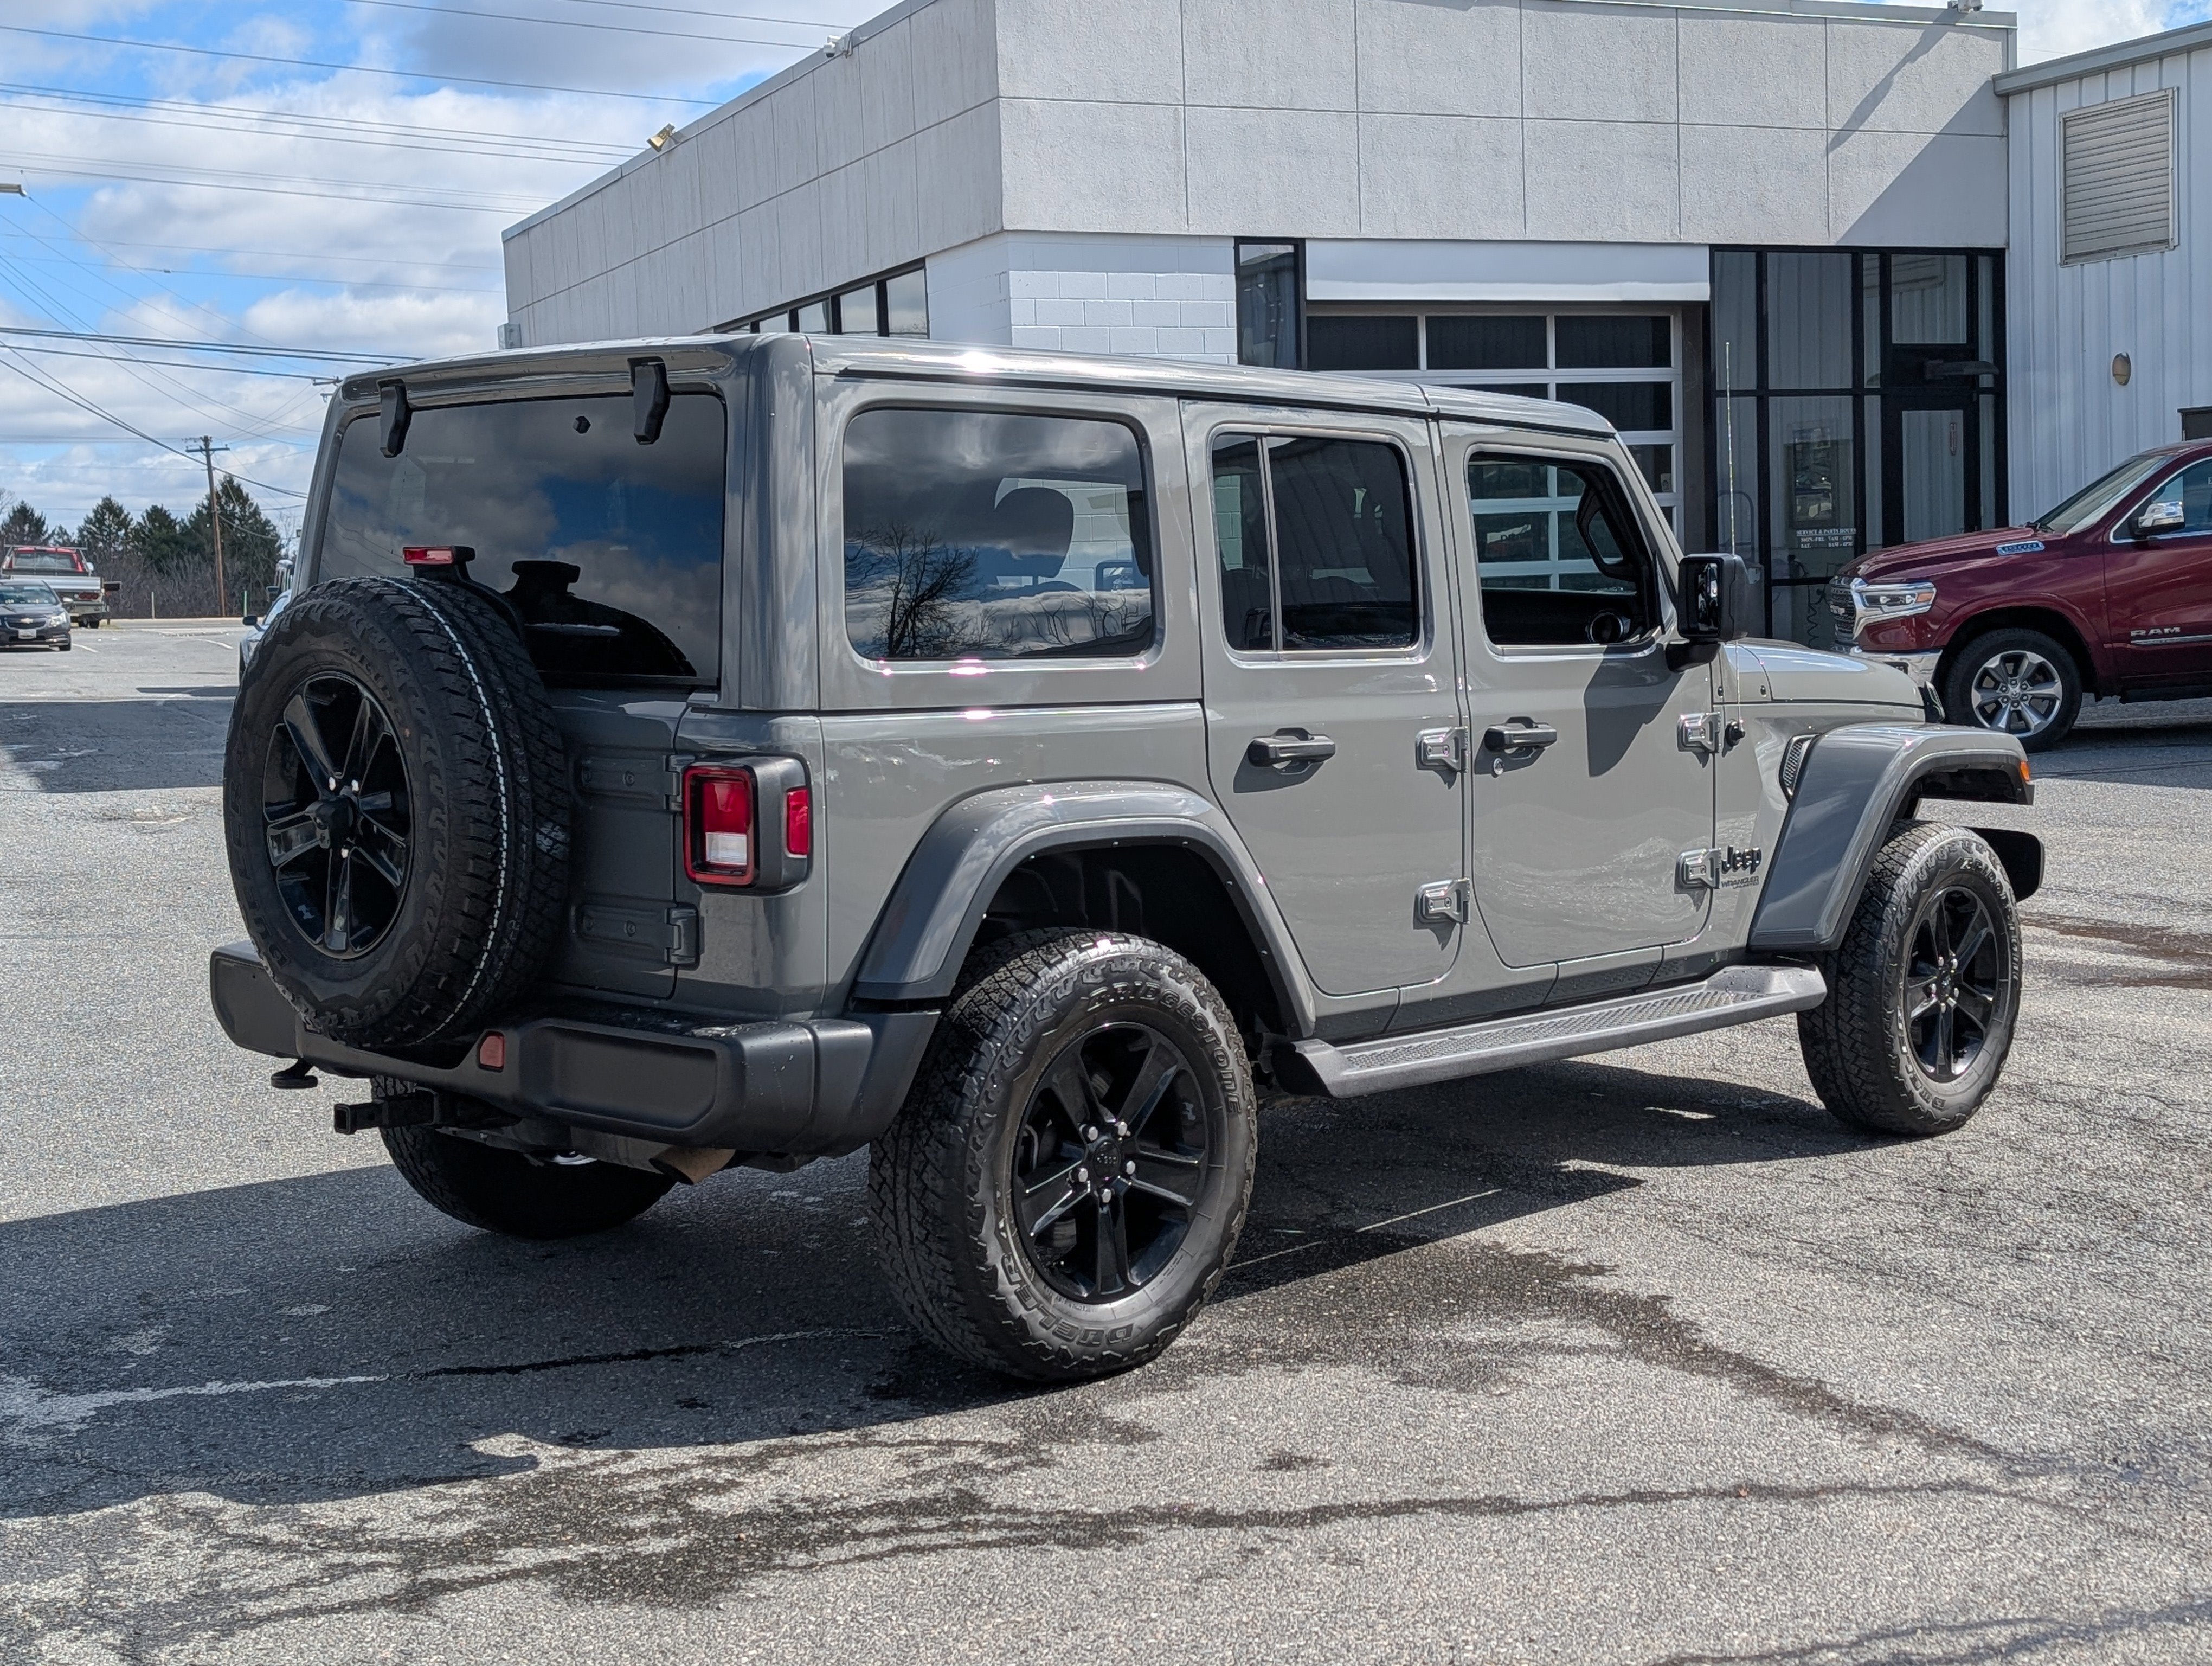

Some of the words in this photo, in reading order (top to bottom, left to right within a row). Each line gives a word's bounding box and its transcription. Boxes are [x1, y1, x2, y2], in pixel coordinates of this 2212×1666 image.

[2131, 627, 2181, 636] RAM
[1721, 845, 1761, 874] Jeep
[1086, 981, 1242, 1113] BRIDGESTONE
[1001, 1253, 1134, 1347] DUELER
